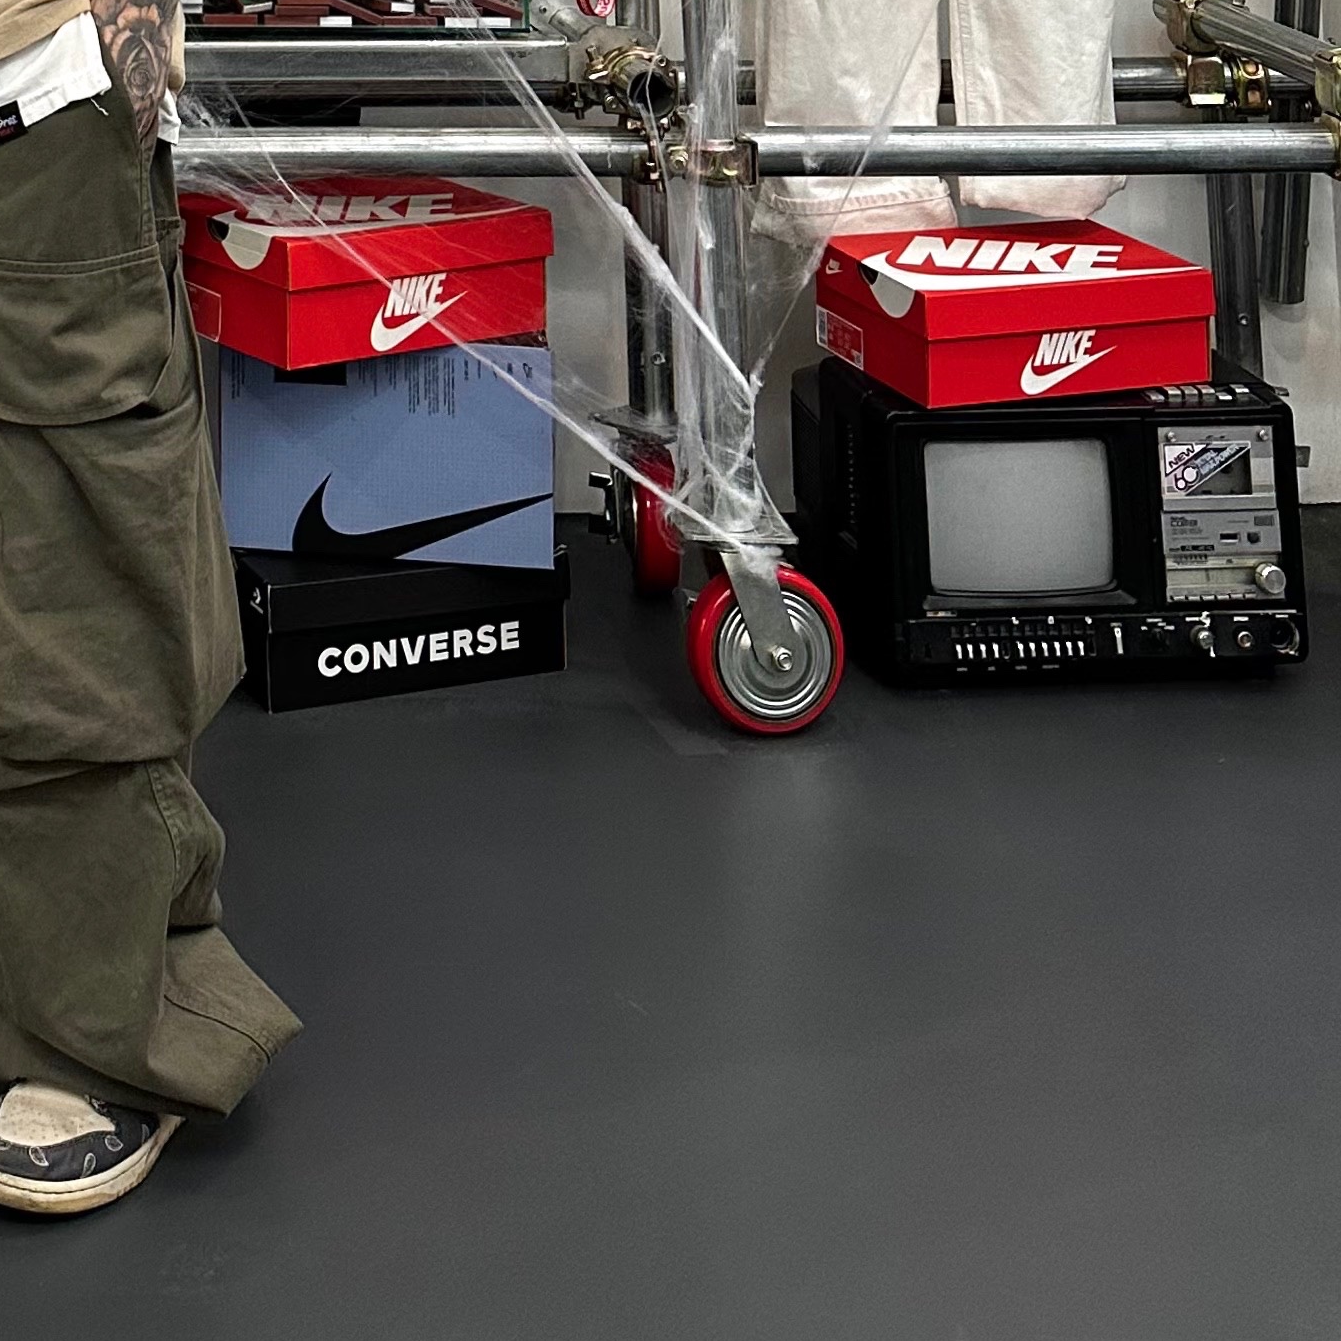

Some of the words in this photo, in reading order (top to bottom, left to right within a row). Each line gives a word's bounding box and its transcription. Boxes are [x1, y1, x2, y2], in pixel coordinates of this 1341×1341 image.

[245, 192, 455, 221] NIKE
[895, 235, 1124, 274] NIKE
[385, 272, 447, 317] NIKE
[1034, 329, 1096, 366] NIKE
[1168, 445, 1196, 469] NEW
[317, 621, 520, 677] CONVERSE
